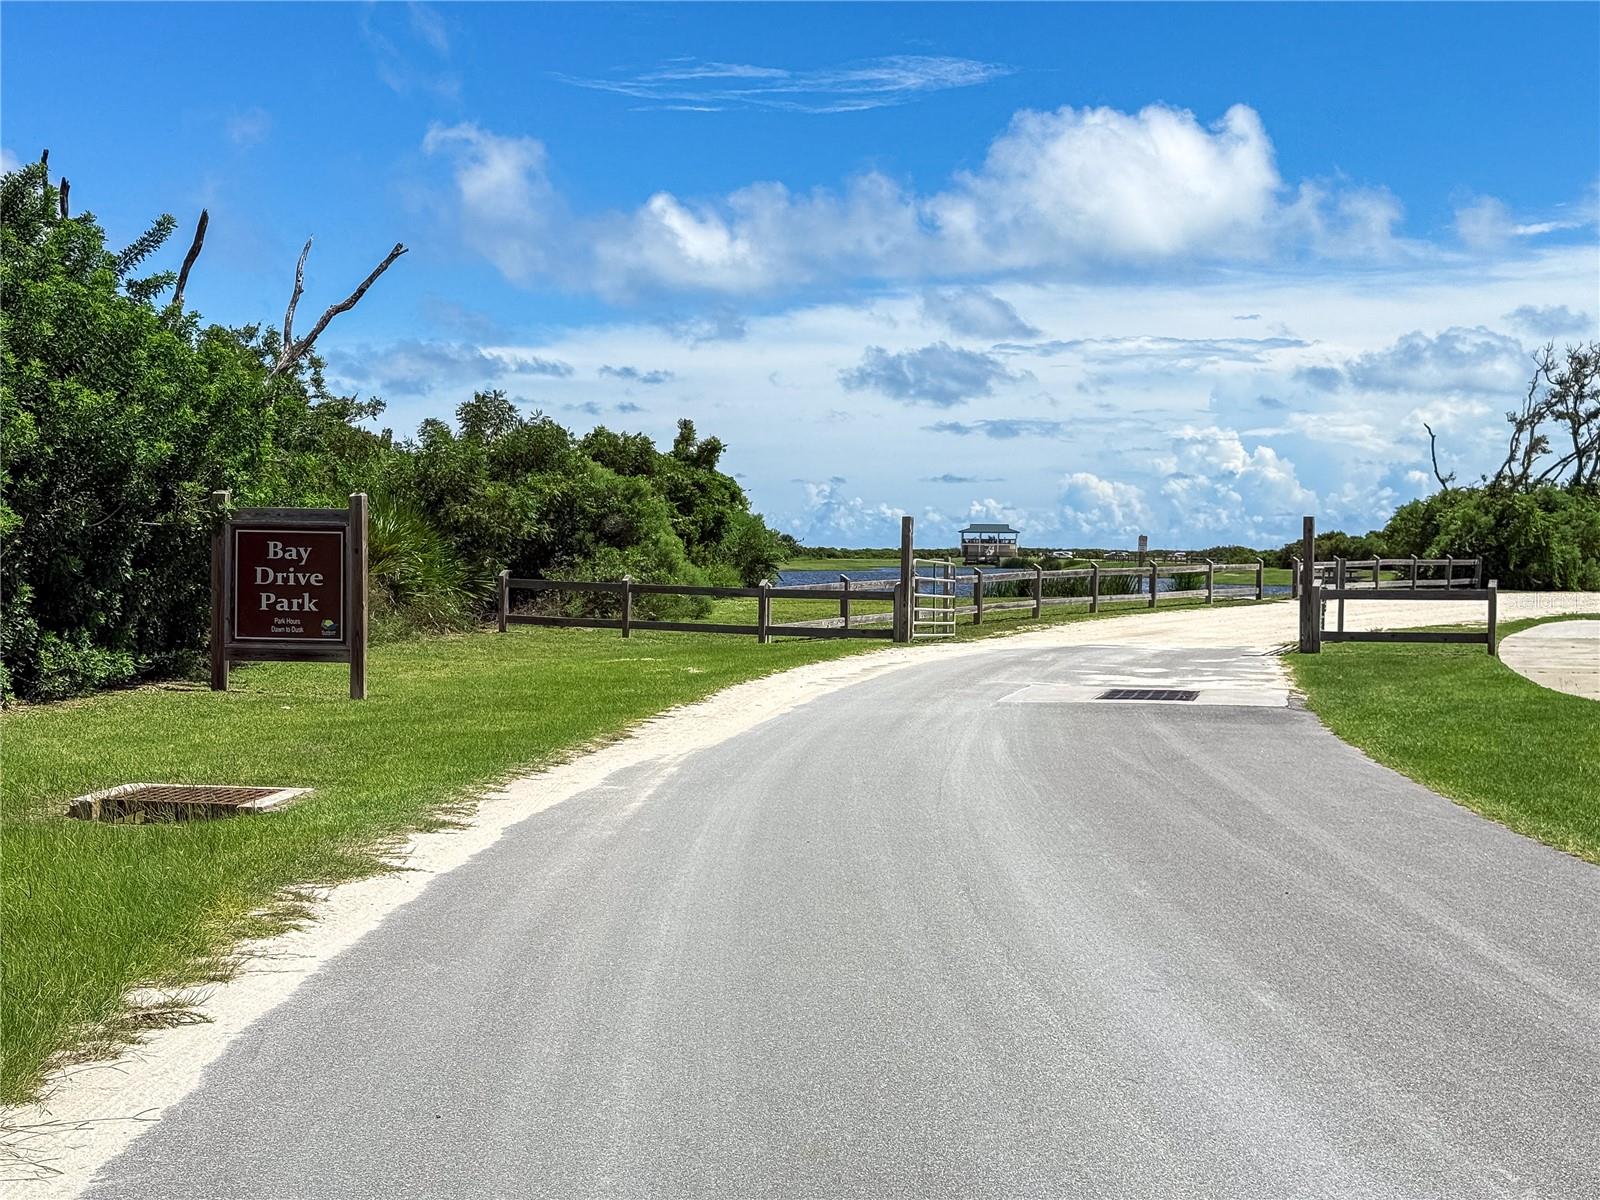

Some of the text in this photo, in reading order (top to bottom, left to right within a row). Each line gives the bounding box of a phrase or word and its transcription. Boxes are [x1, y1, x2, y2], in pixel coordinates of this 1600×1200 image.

[266, 540, 312, 566] Bay
[254, 566, 324, 586] Drive
[259, 592, 320, 612] Park
[271, 625, 285, 633] Dawn
[274, 617, 301, 625] Park Hours
